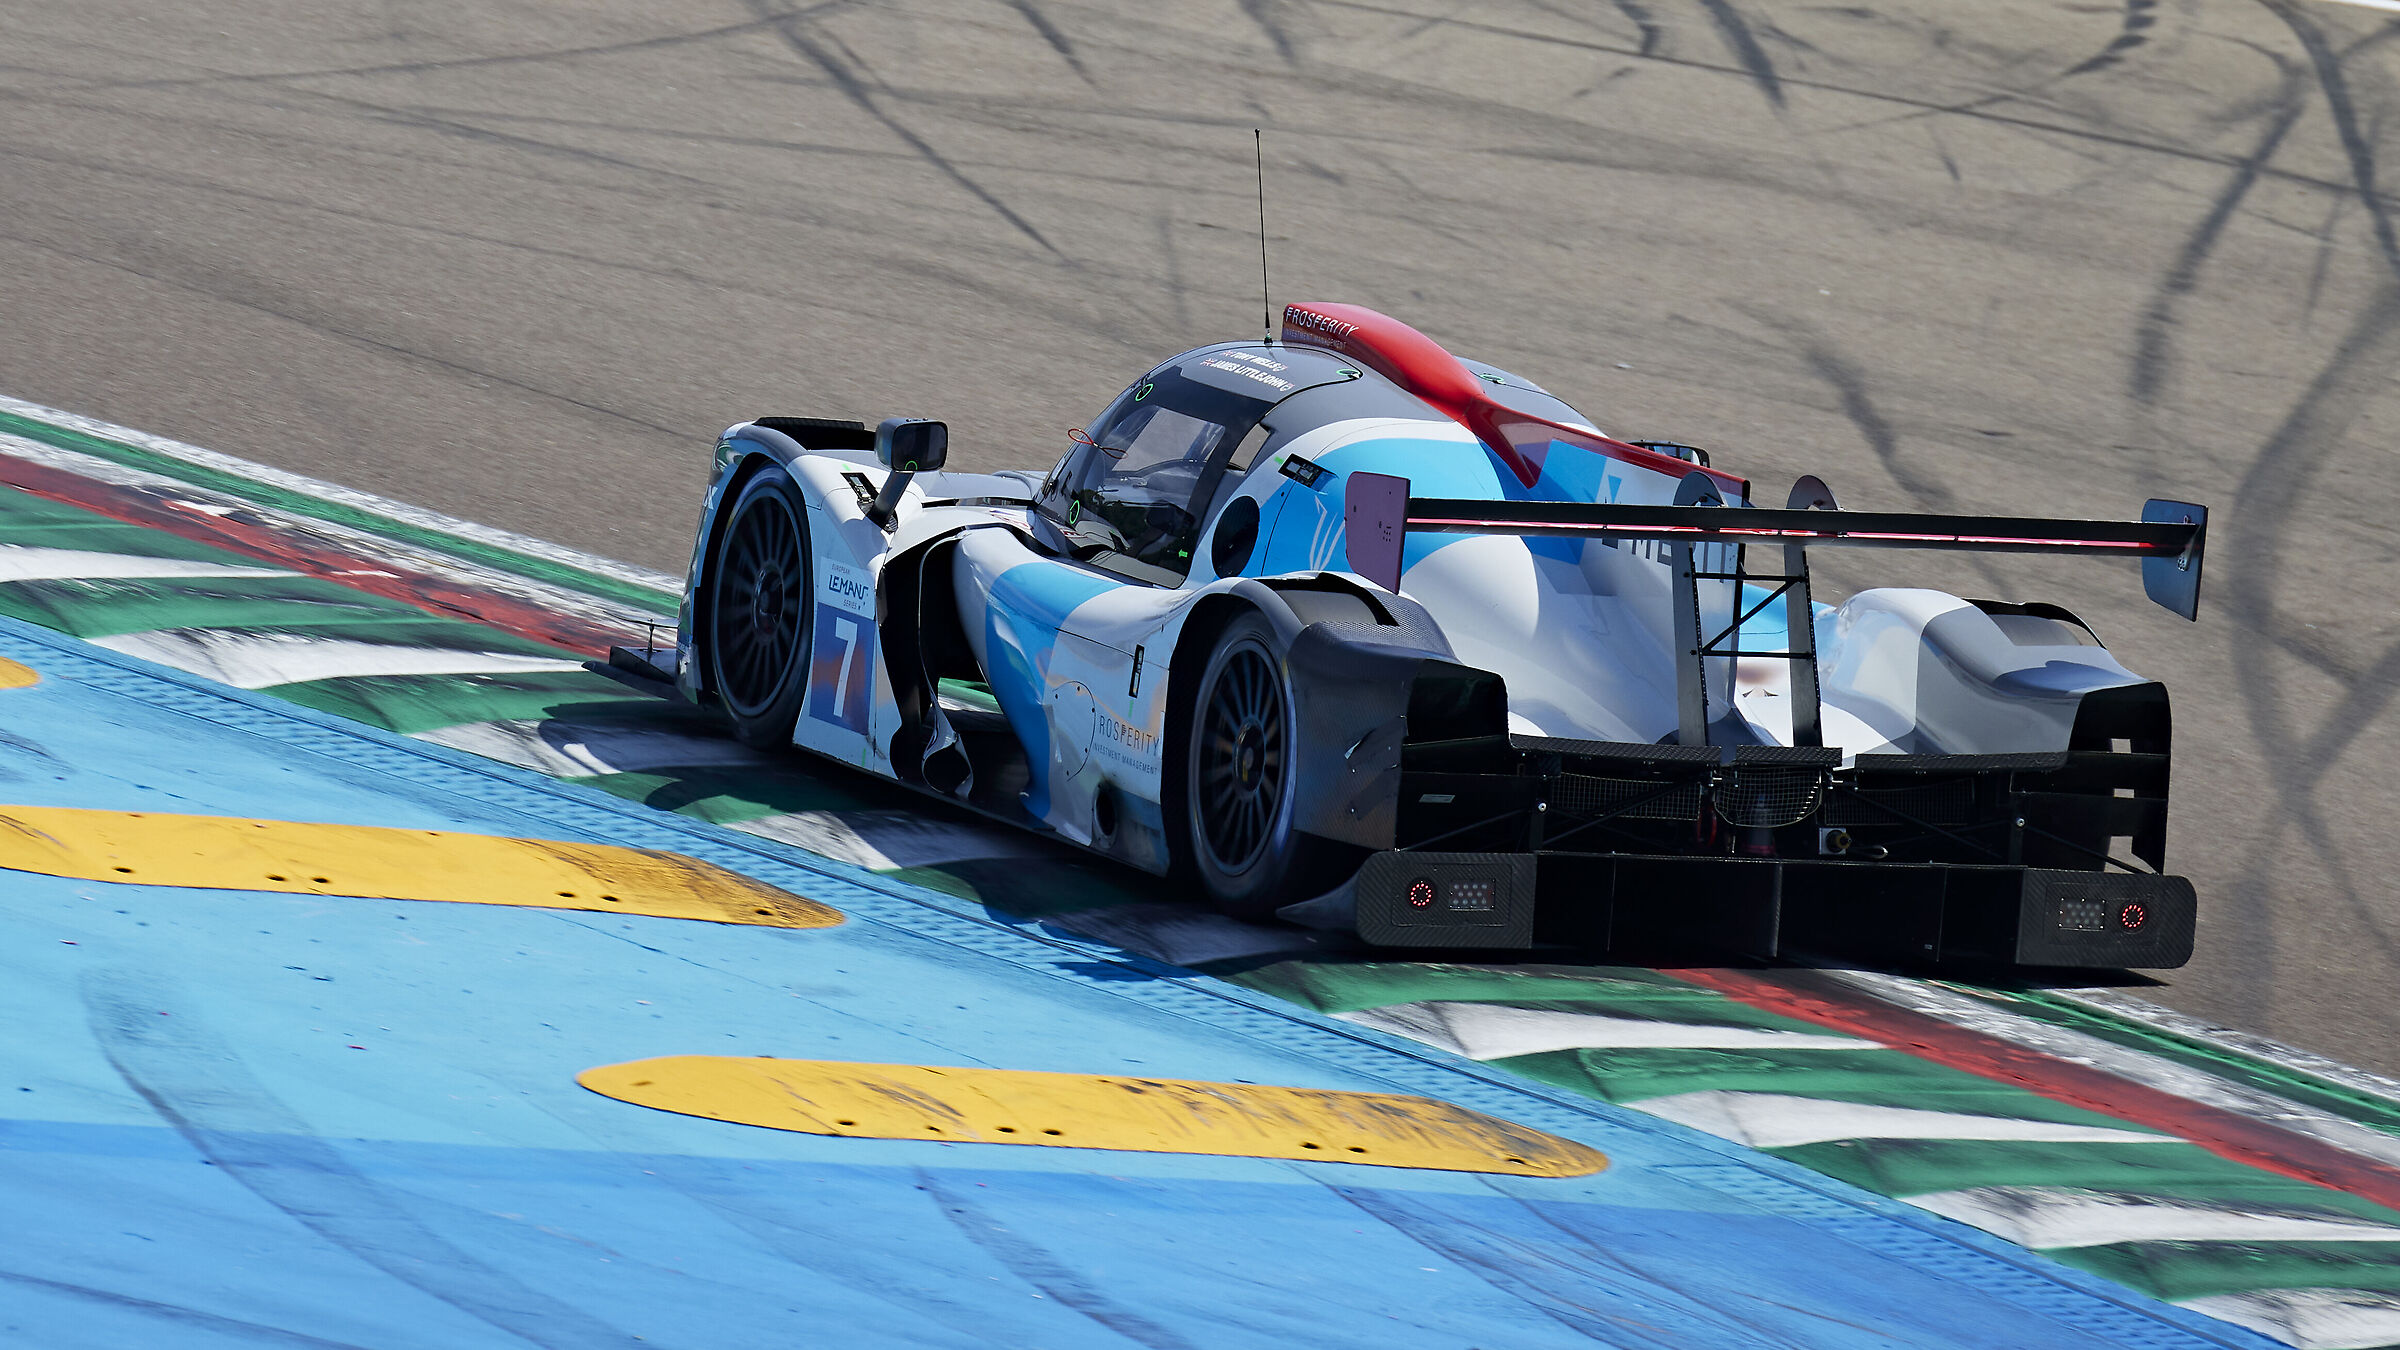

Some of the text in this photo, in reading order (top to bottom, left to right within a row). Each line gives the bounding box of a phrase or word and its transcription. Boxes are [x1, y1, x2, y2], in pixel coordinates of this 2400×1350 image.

[1285, 306, 1360, 337] PROSPERITY
[1210, 360, 1288, 389] JAMES LITTLEJOHN
[843, 599, 858, 610] SERIES
[833, 616, 858, 718] 7
[1092, 742, 1158, 774] INVESTMENT MANAGEMENT
